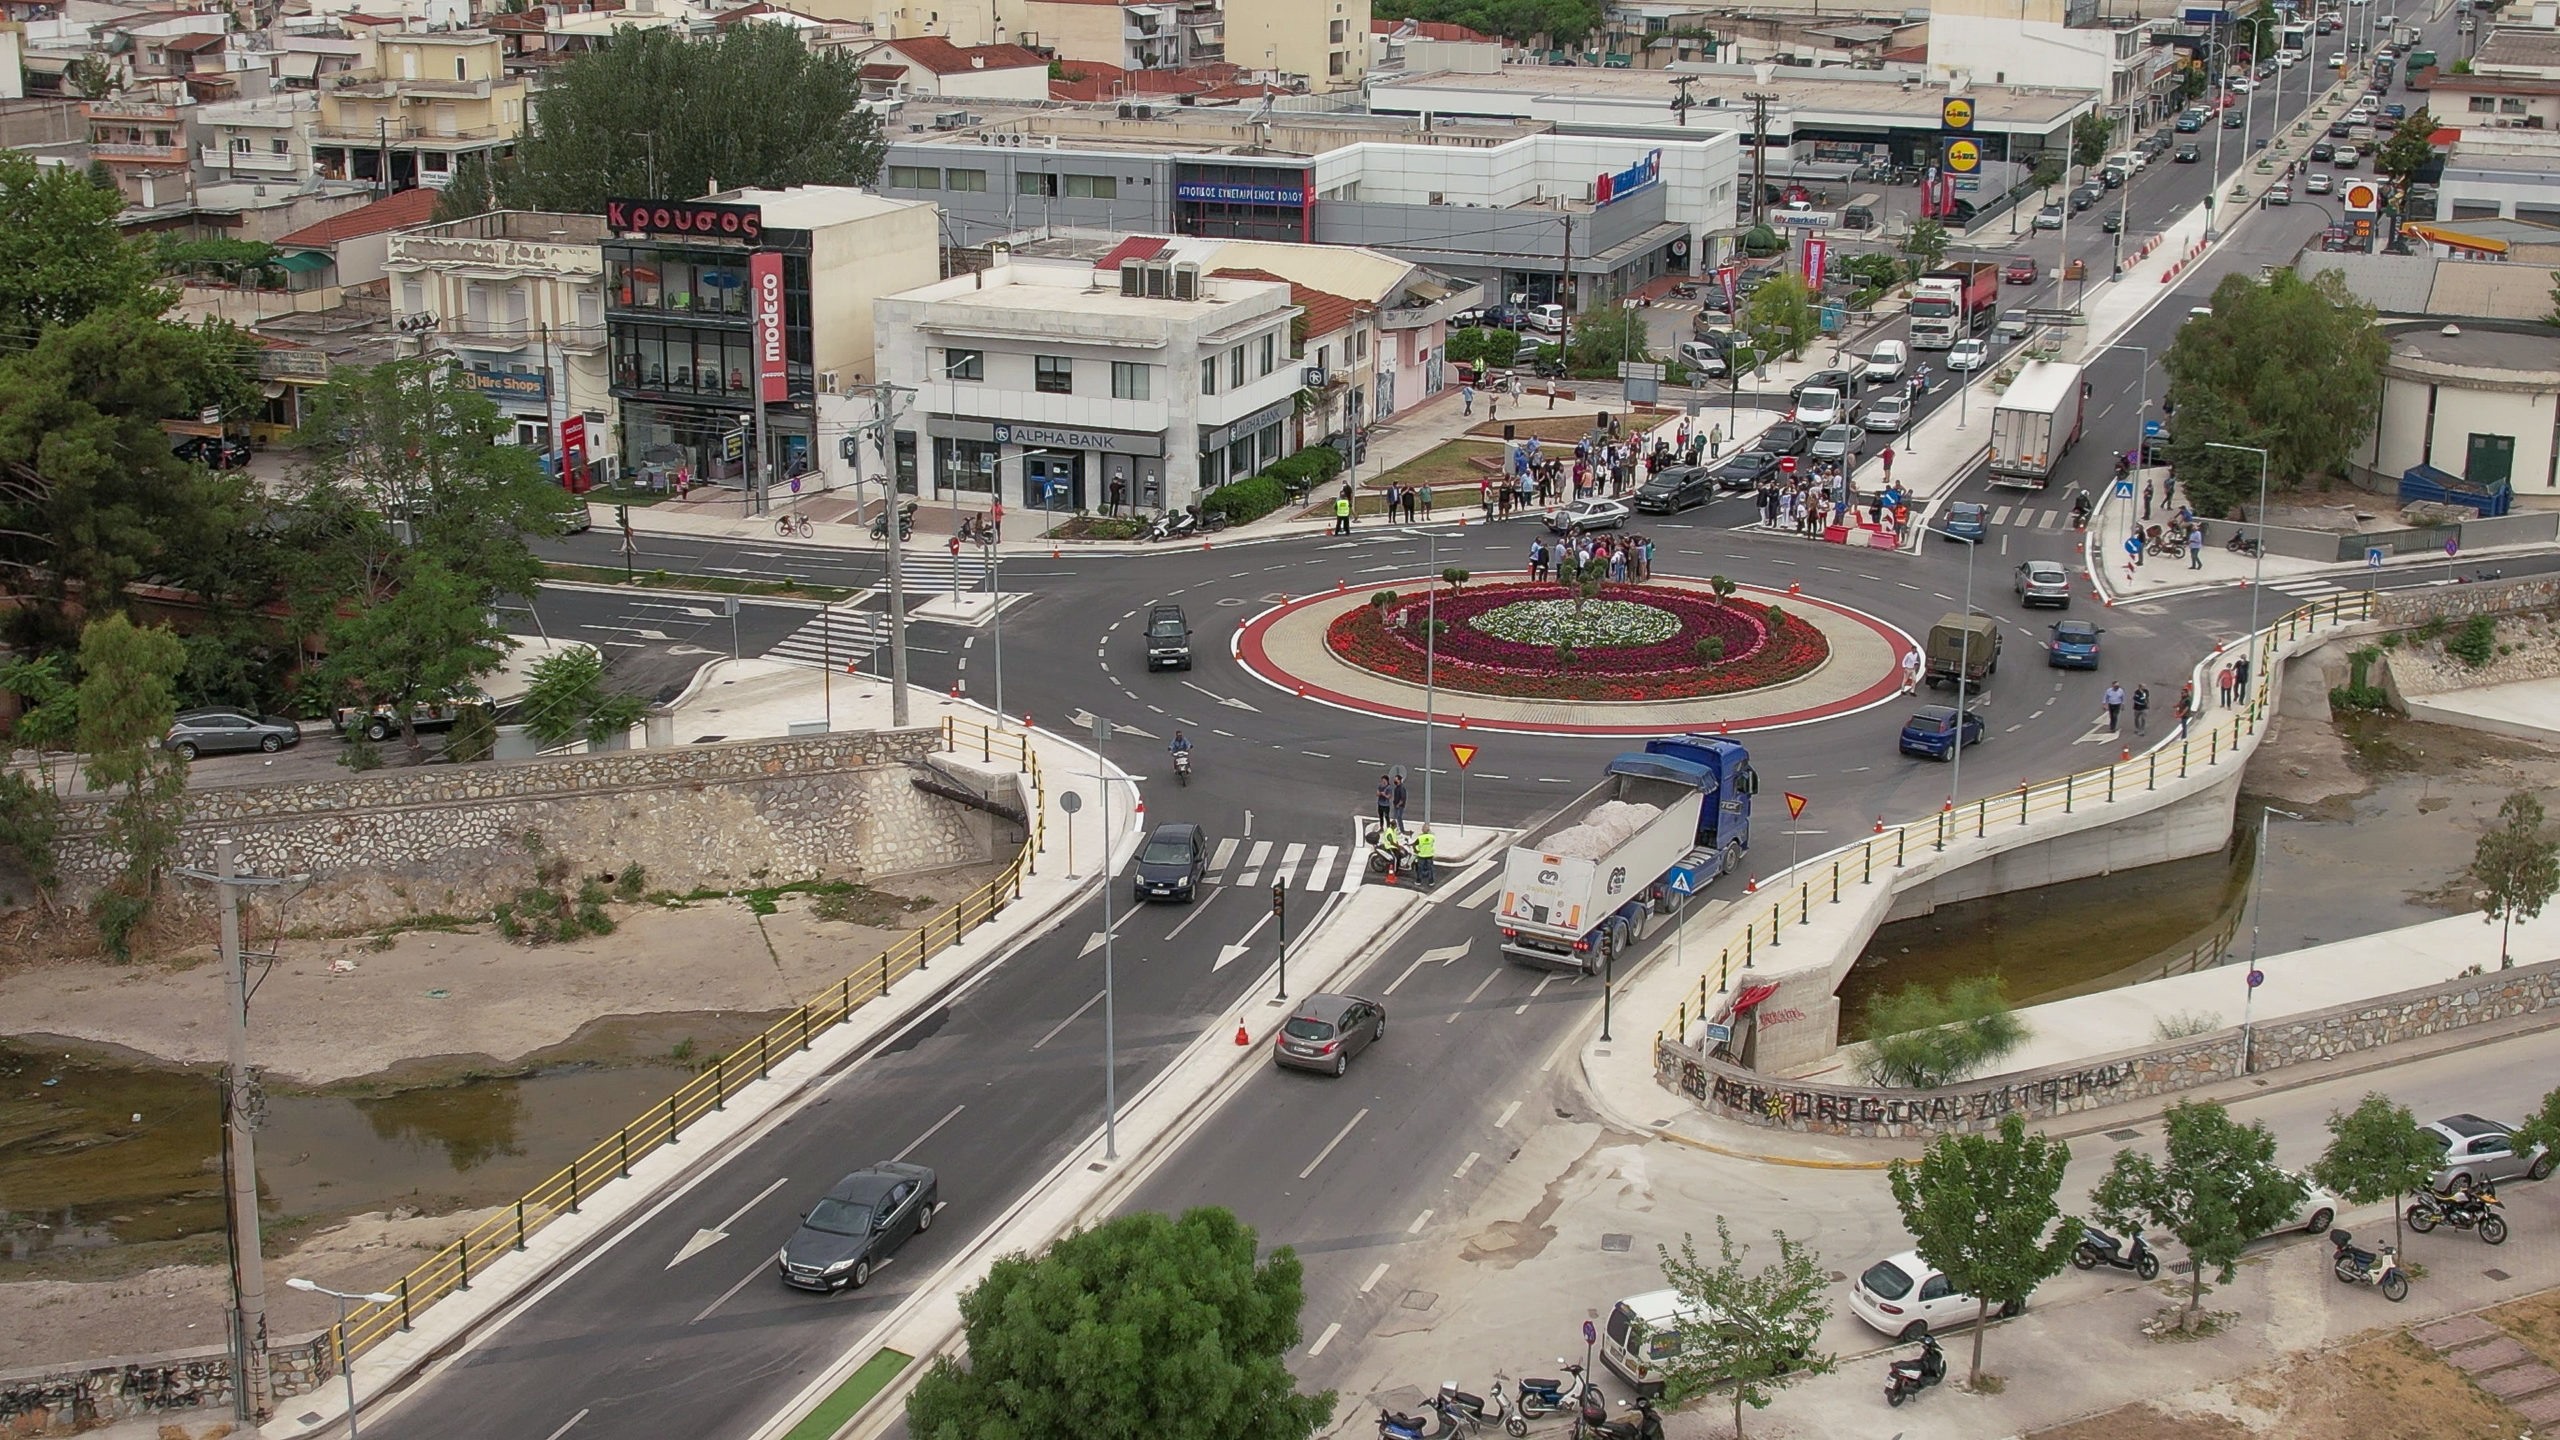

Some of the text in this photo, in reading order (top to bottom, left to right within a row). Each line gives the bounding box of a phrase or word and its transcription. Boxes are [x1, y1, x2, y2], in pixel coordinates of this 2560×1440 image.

[761, 273, 780, 362] modeco
[503, 377, 541, 393] Shops
[1238, 407, 1281, 435] ALPHA BANK
[1015, 429, 1116, 449] ALPHA BANK
